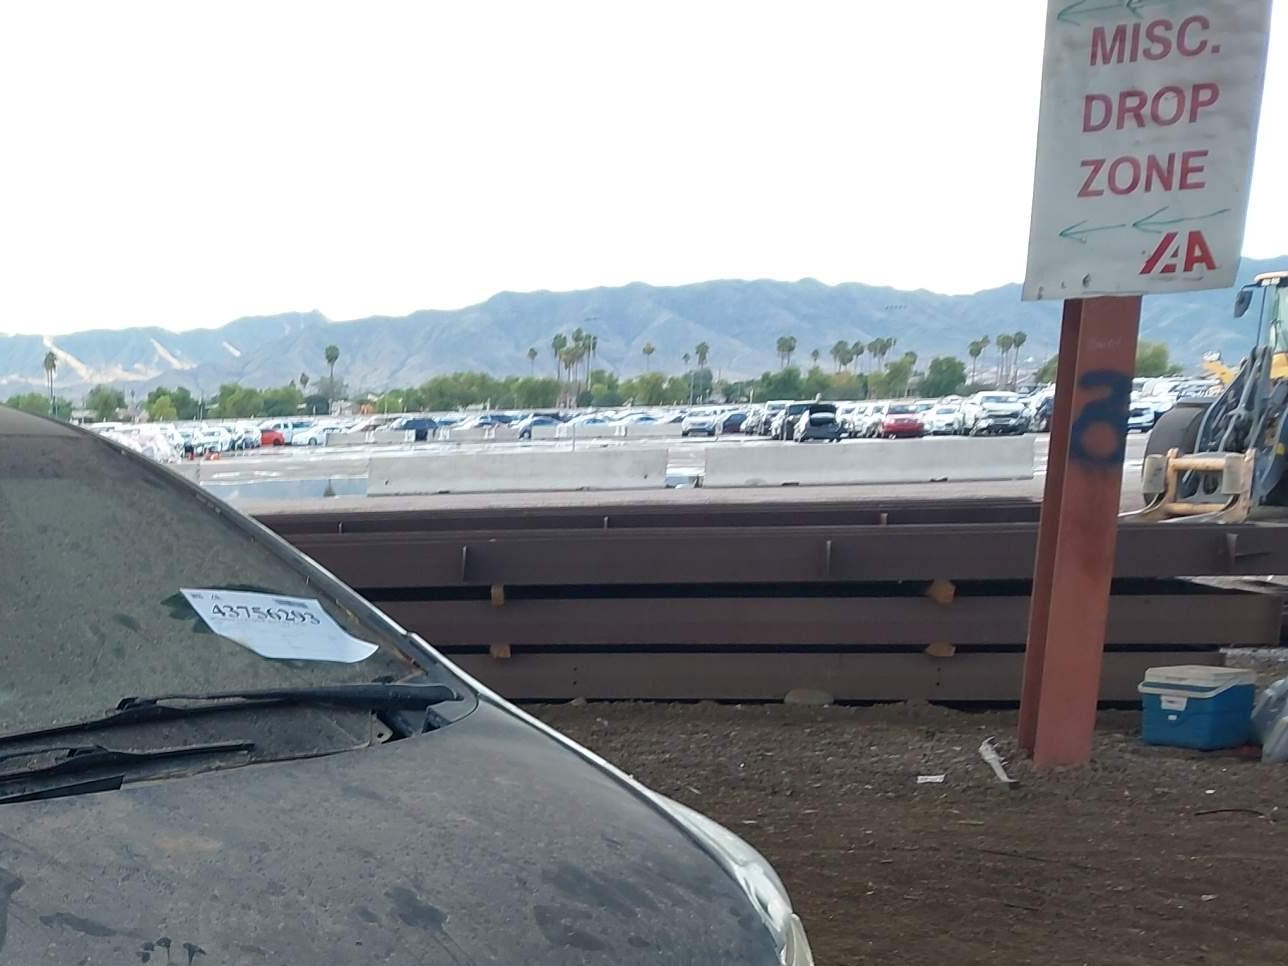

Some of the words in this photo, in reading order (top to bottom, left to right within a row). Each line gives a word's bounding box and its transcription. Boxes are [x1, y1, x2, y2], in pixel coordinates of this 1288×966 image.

[1089, 15, 1222, 66] MISC.
[1081, 82, 1220, 133] DROP
[1077, 150, 1209, 198] ZONE
[212, 604, 321, 625] 43756293
